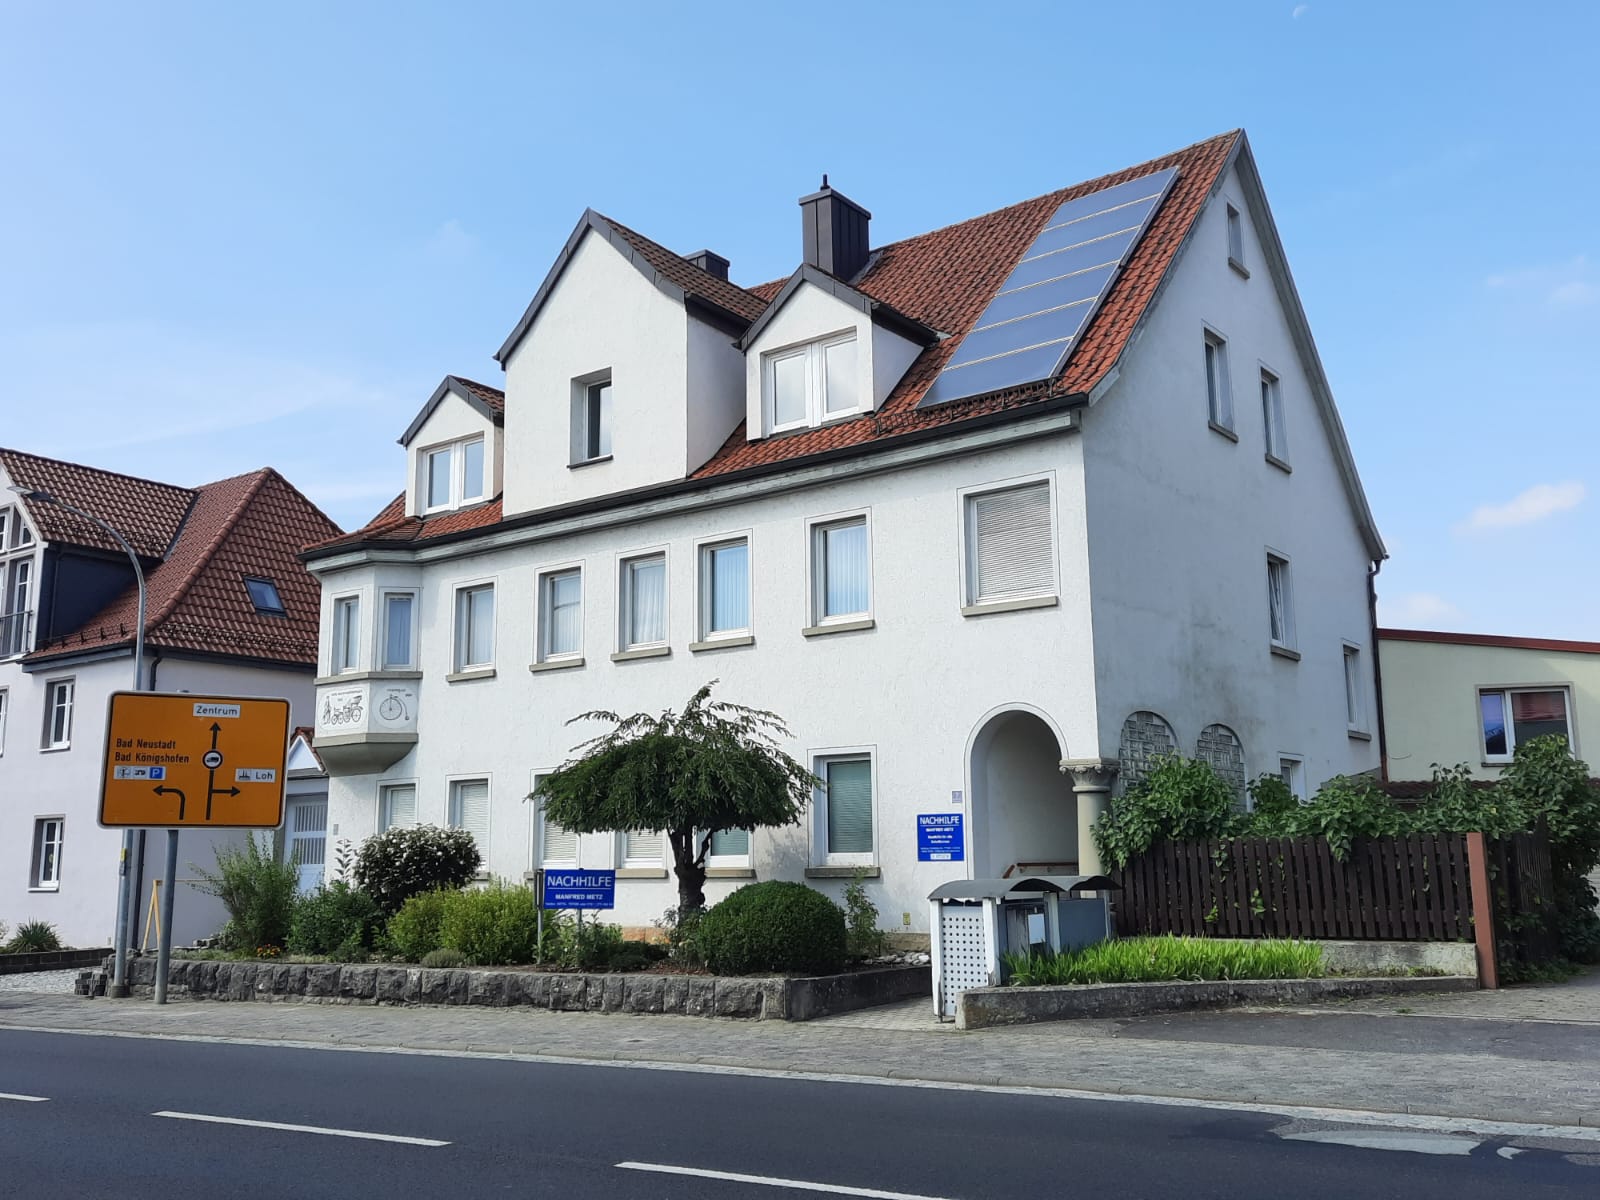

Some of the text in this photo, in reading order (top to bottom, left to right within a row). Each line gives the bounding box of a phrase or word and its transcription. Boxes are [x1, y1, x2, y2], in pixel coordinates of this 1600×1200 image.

[196, 705, 238, 716] Zentrum
[116, 739, 176, 749] Bad Neustadt
[115, 752, 189, 764] Bad Königshofen
[255, 769, 273, 780] Loh
[920, 816, 959, 825] NACHHILFE
[547, 876, 612, 887] NACHHILFE
